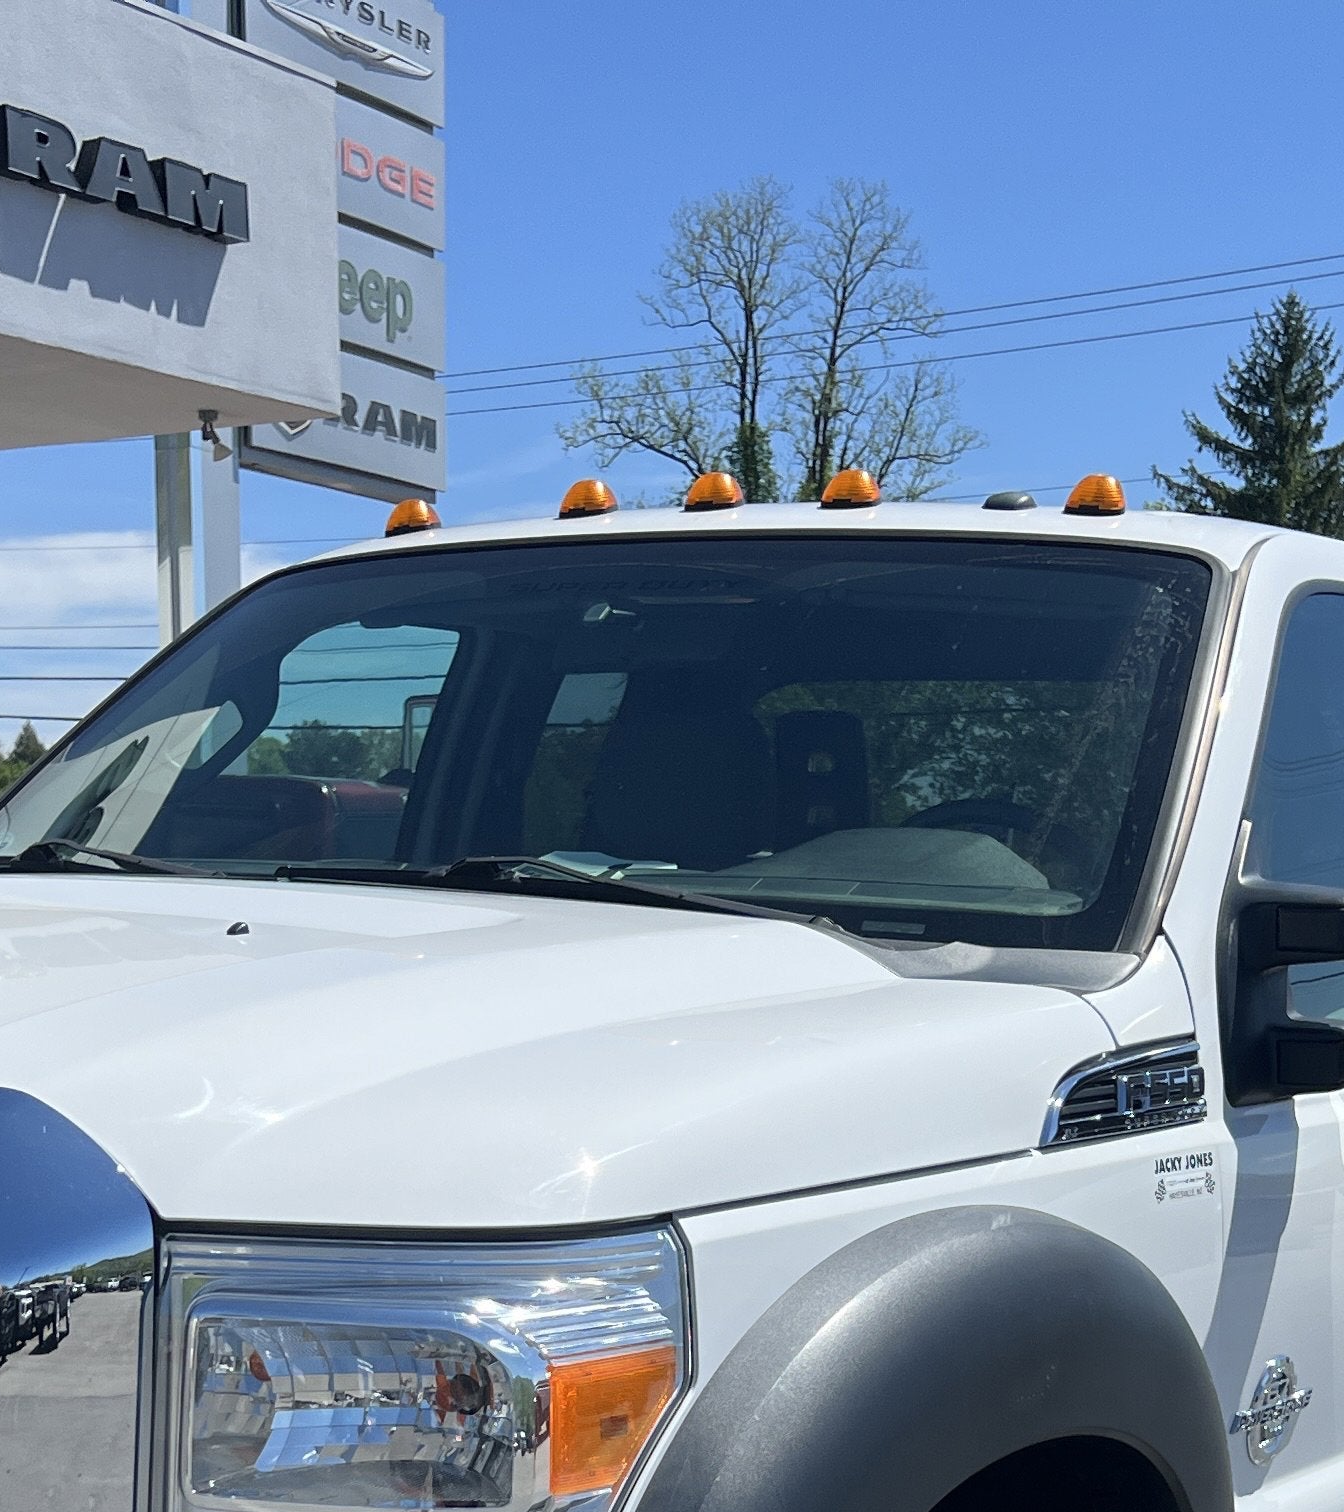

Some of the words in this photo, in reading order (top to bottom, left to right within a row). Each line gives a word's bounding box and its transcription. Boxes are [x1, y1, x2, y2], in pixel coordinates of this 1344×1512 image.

[316, 0, 432, 53] YSLER
[336, 137, 436, 211] DGE
[338, 259, 413, 343] eep
[1154, 1156, 1182, 1174] JACKY
[1185, 1151, 1213, 1170] JONES
